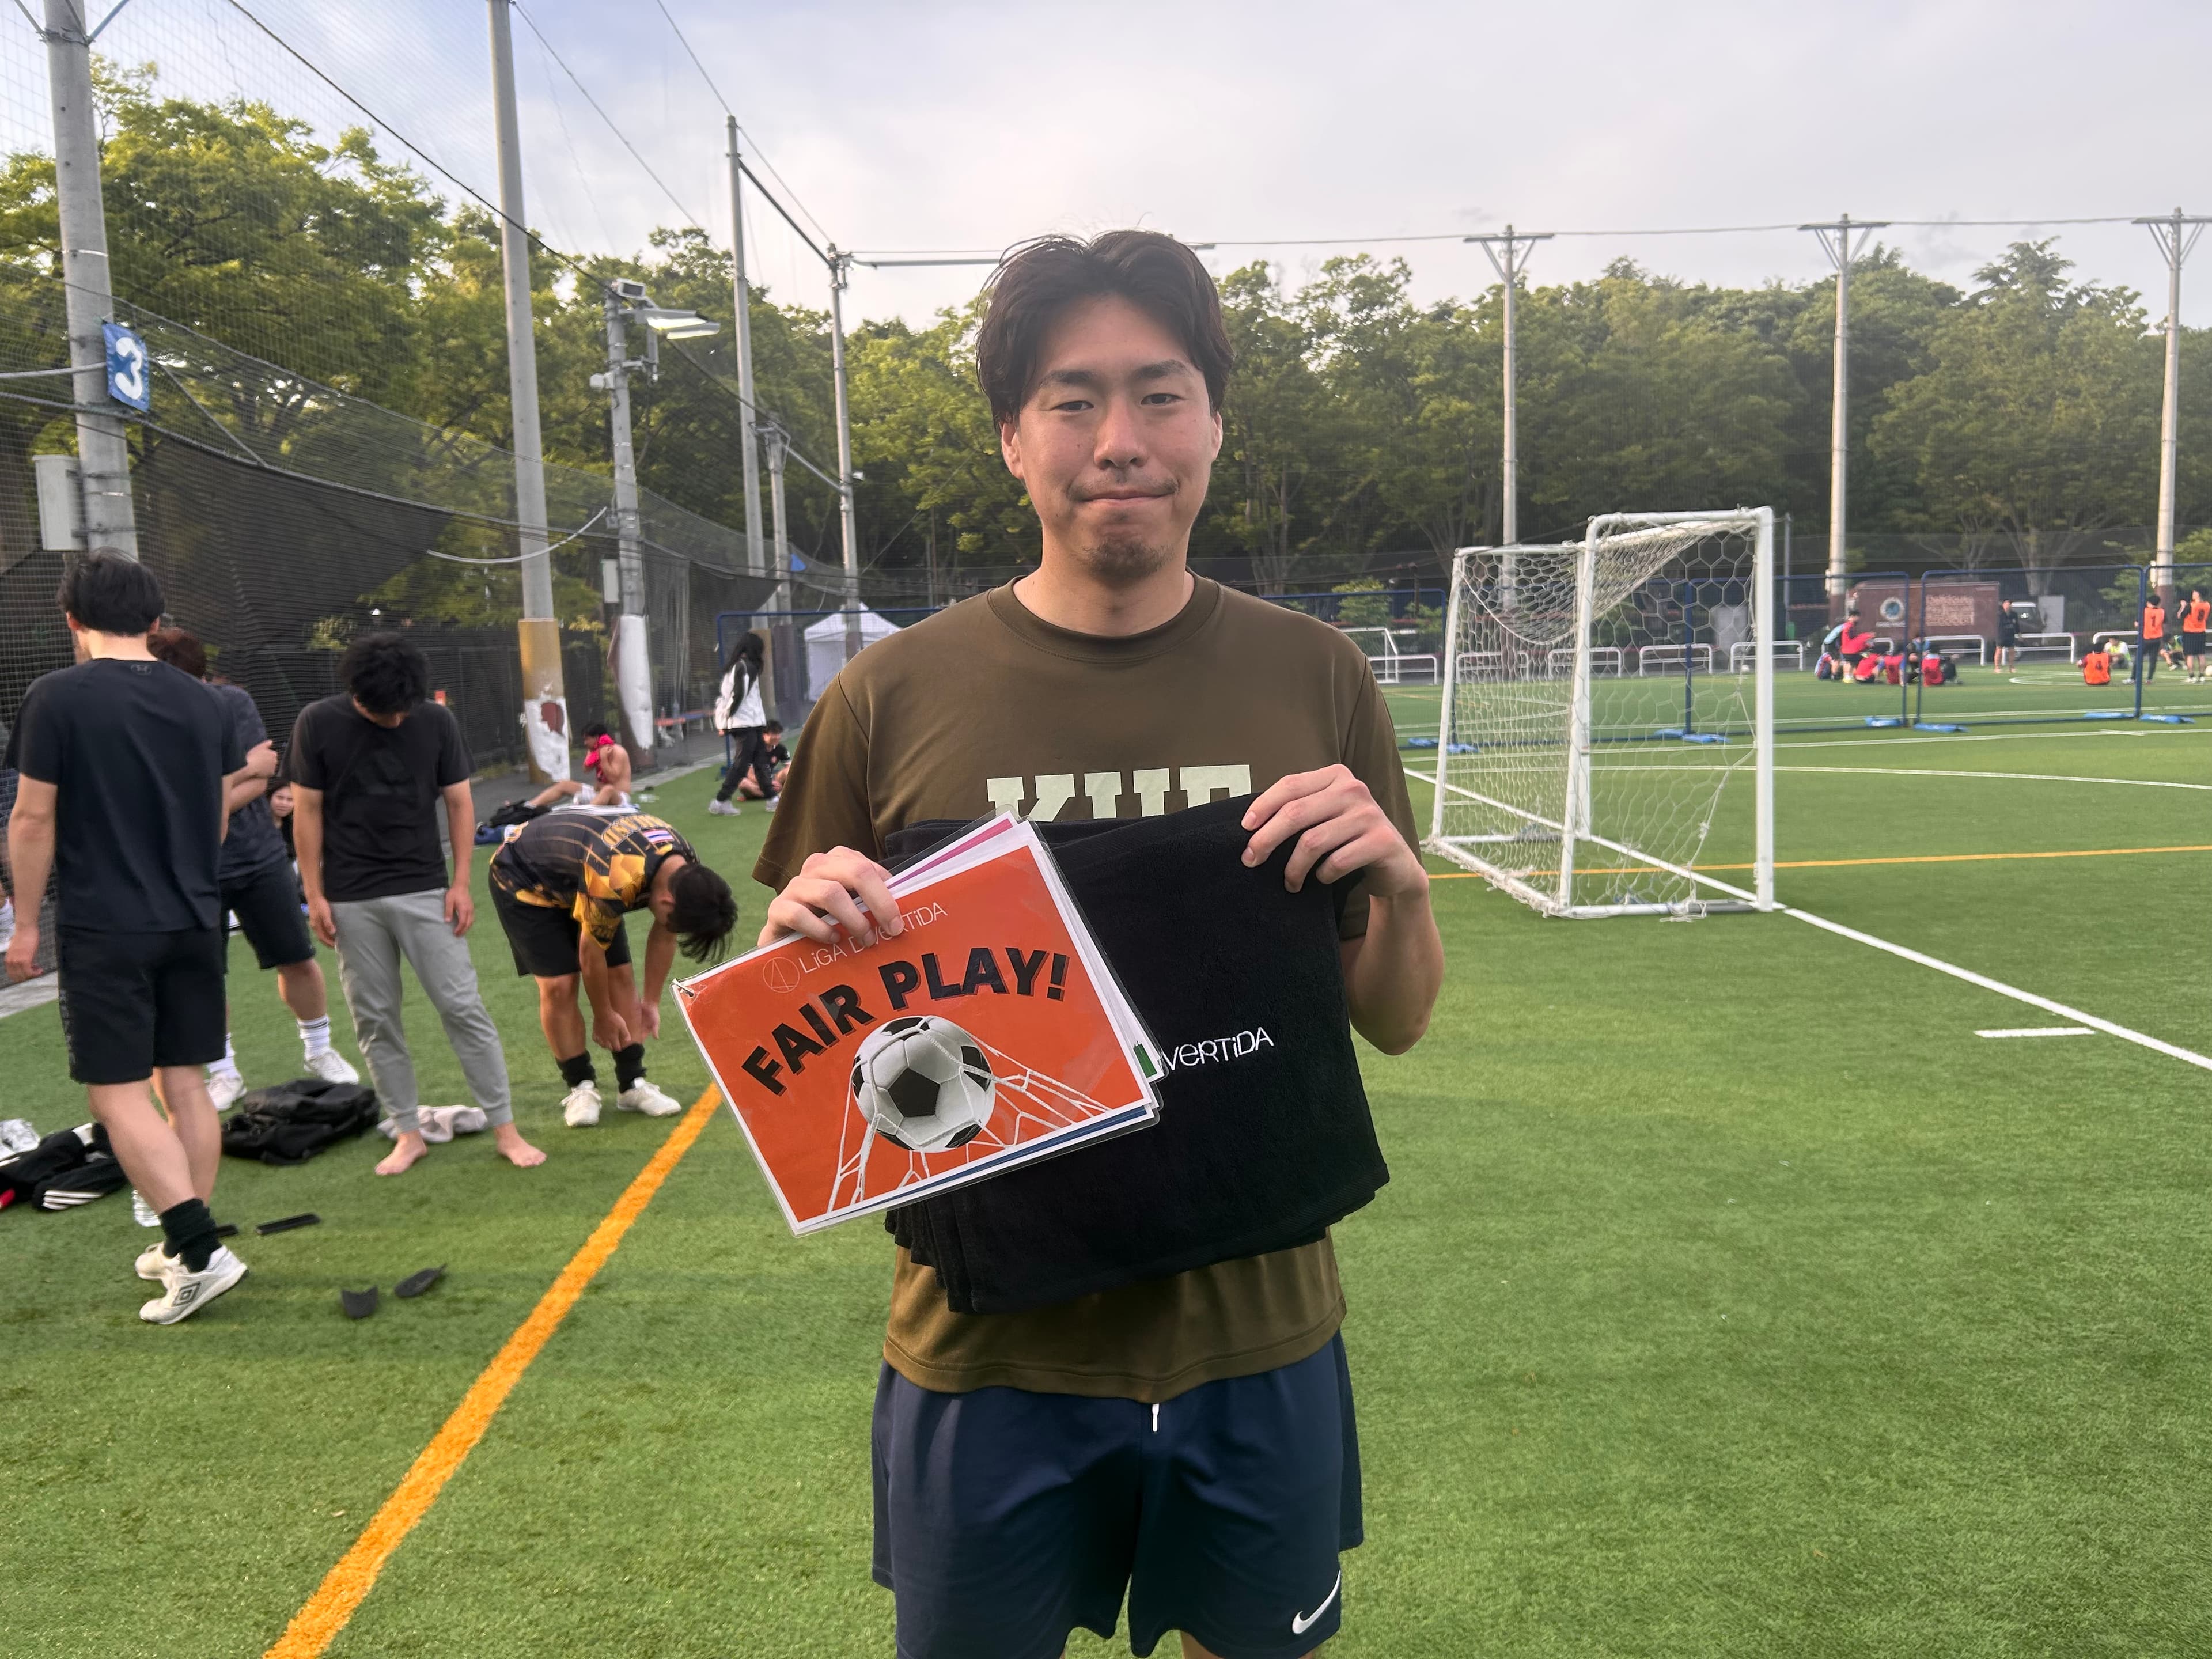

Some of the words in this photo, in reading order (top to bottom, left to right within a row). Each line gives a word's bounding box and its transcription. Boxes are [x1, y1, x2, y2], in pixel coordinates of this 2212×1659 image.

[115, 336, 143, 400] 3
[741, 983, 876, 1096] FAIR
[878, 946, 1070, 1011] PLAY!
